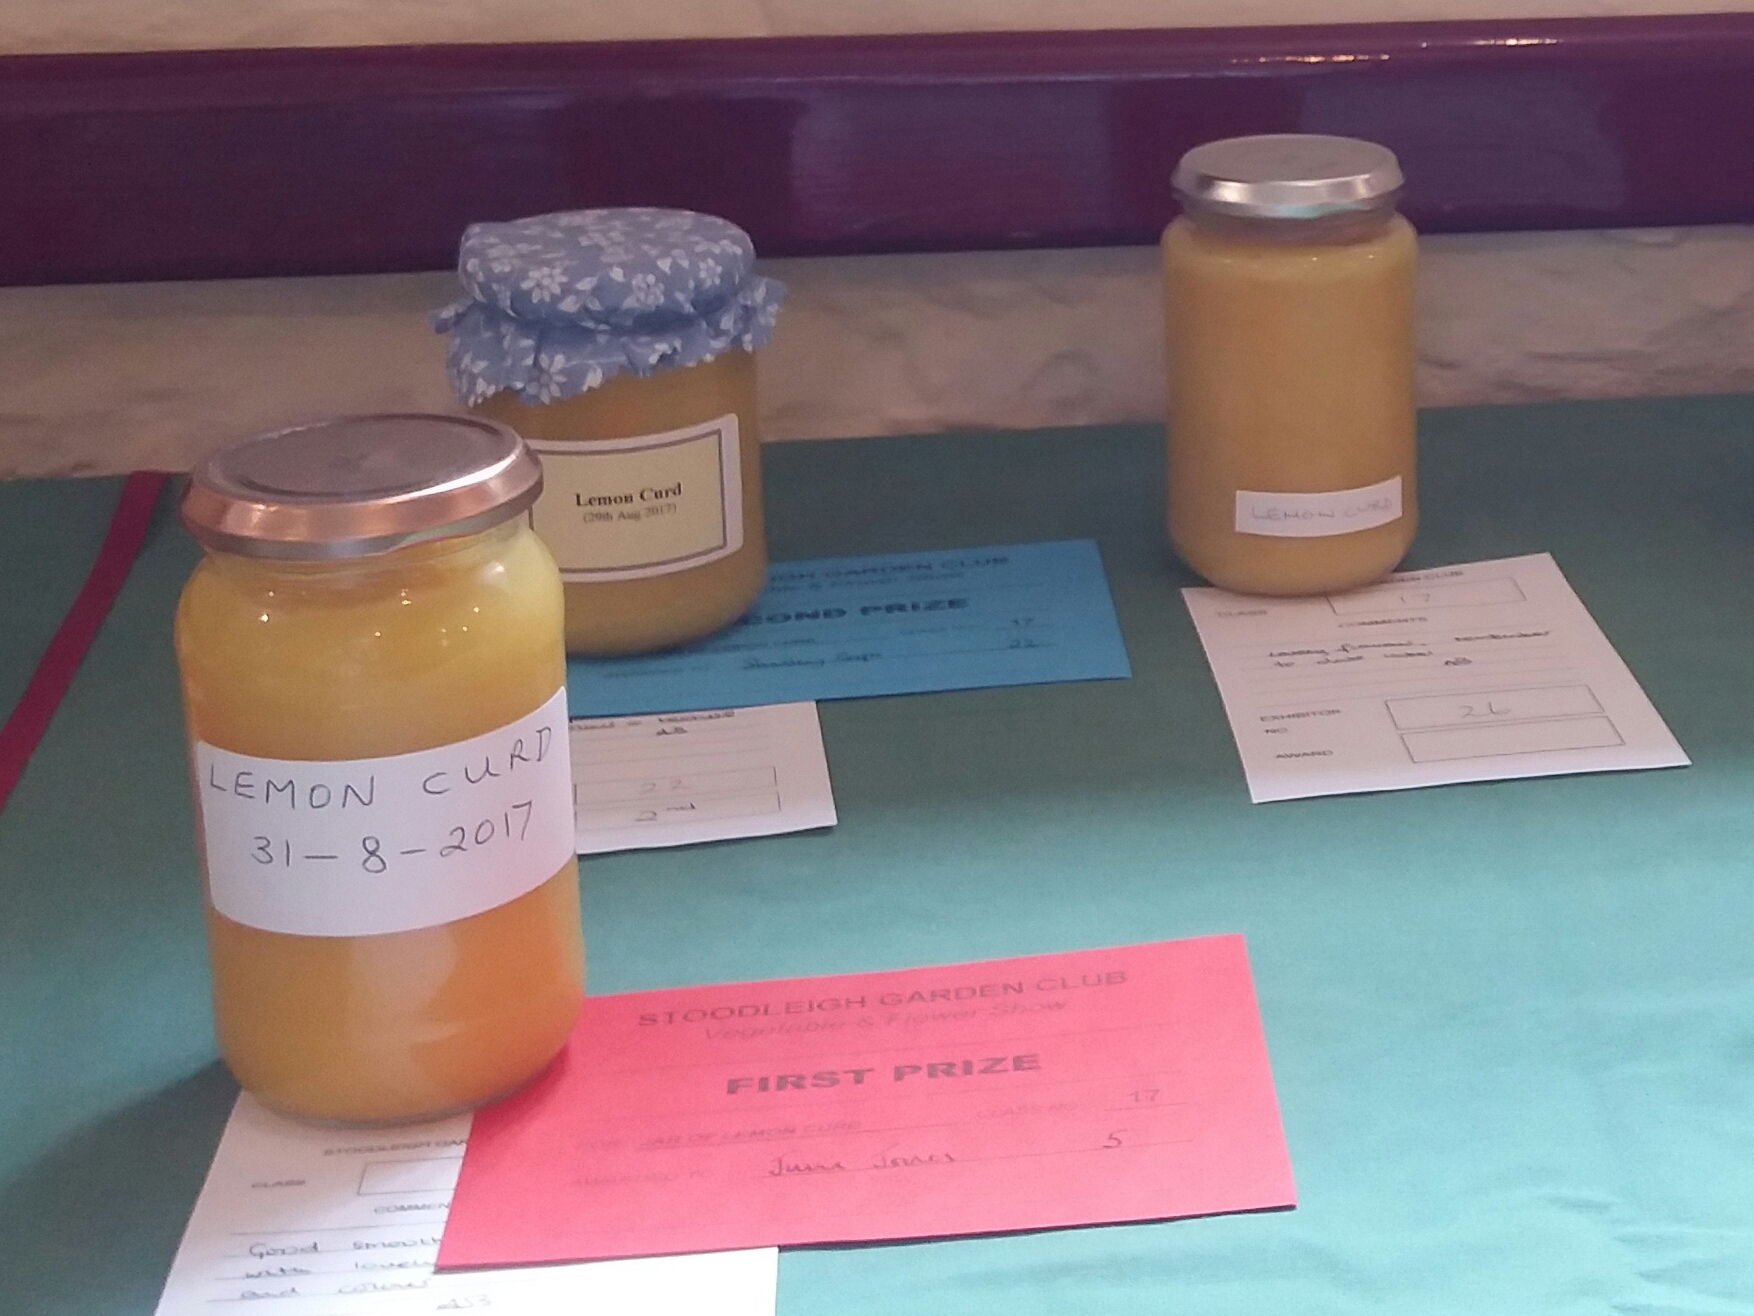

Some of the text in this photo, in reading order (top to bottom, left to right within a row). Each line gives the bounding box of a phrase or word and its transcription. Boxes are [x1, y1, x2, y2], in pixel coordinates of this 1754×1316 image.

[575, 481, 682, 507] Lemon Curd
[618, 511, 641, 521] Aug
[1252, 505, 1335, 521] LEMON
[859, 597, 969, 616] PRIZE
[209, 726, 552, 810] LEMON CURD
[637, 970, 1129, 1028] STOODLEIGH GARDEN CLUB
[726, 1053, 1041, 1095] FIRST PRIZE
[1129, 1088, 1160, 1103] 17
[1103, 1128, 1129, 1150] 5
[374, 1202, 450, 1214] COMMEN
